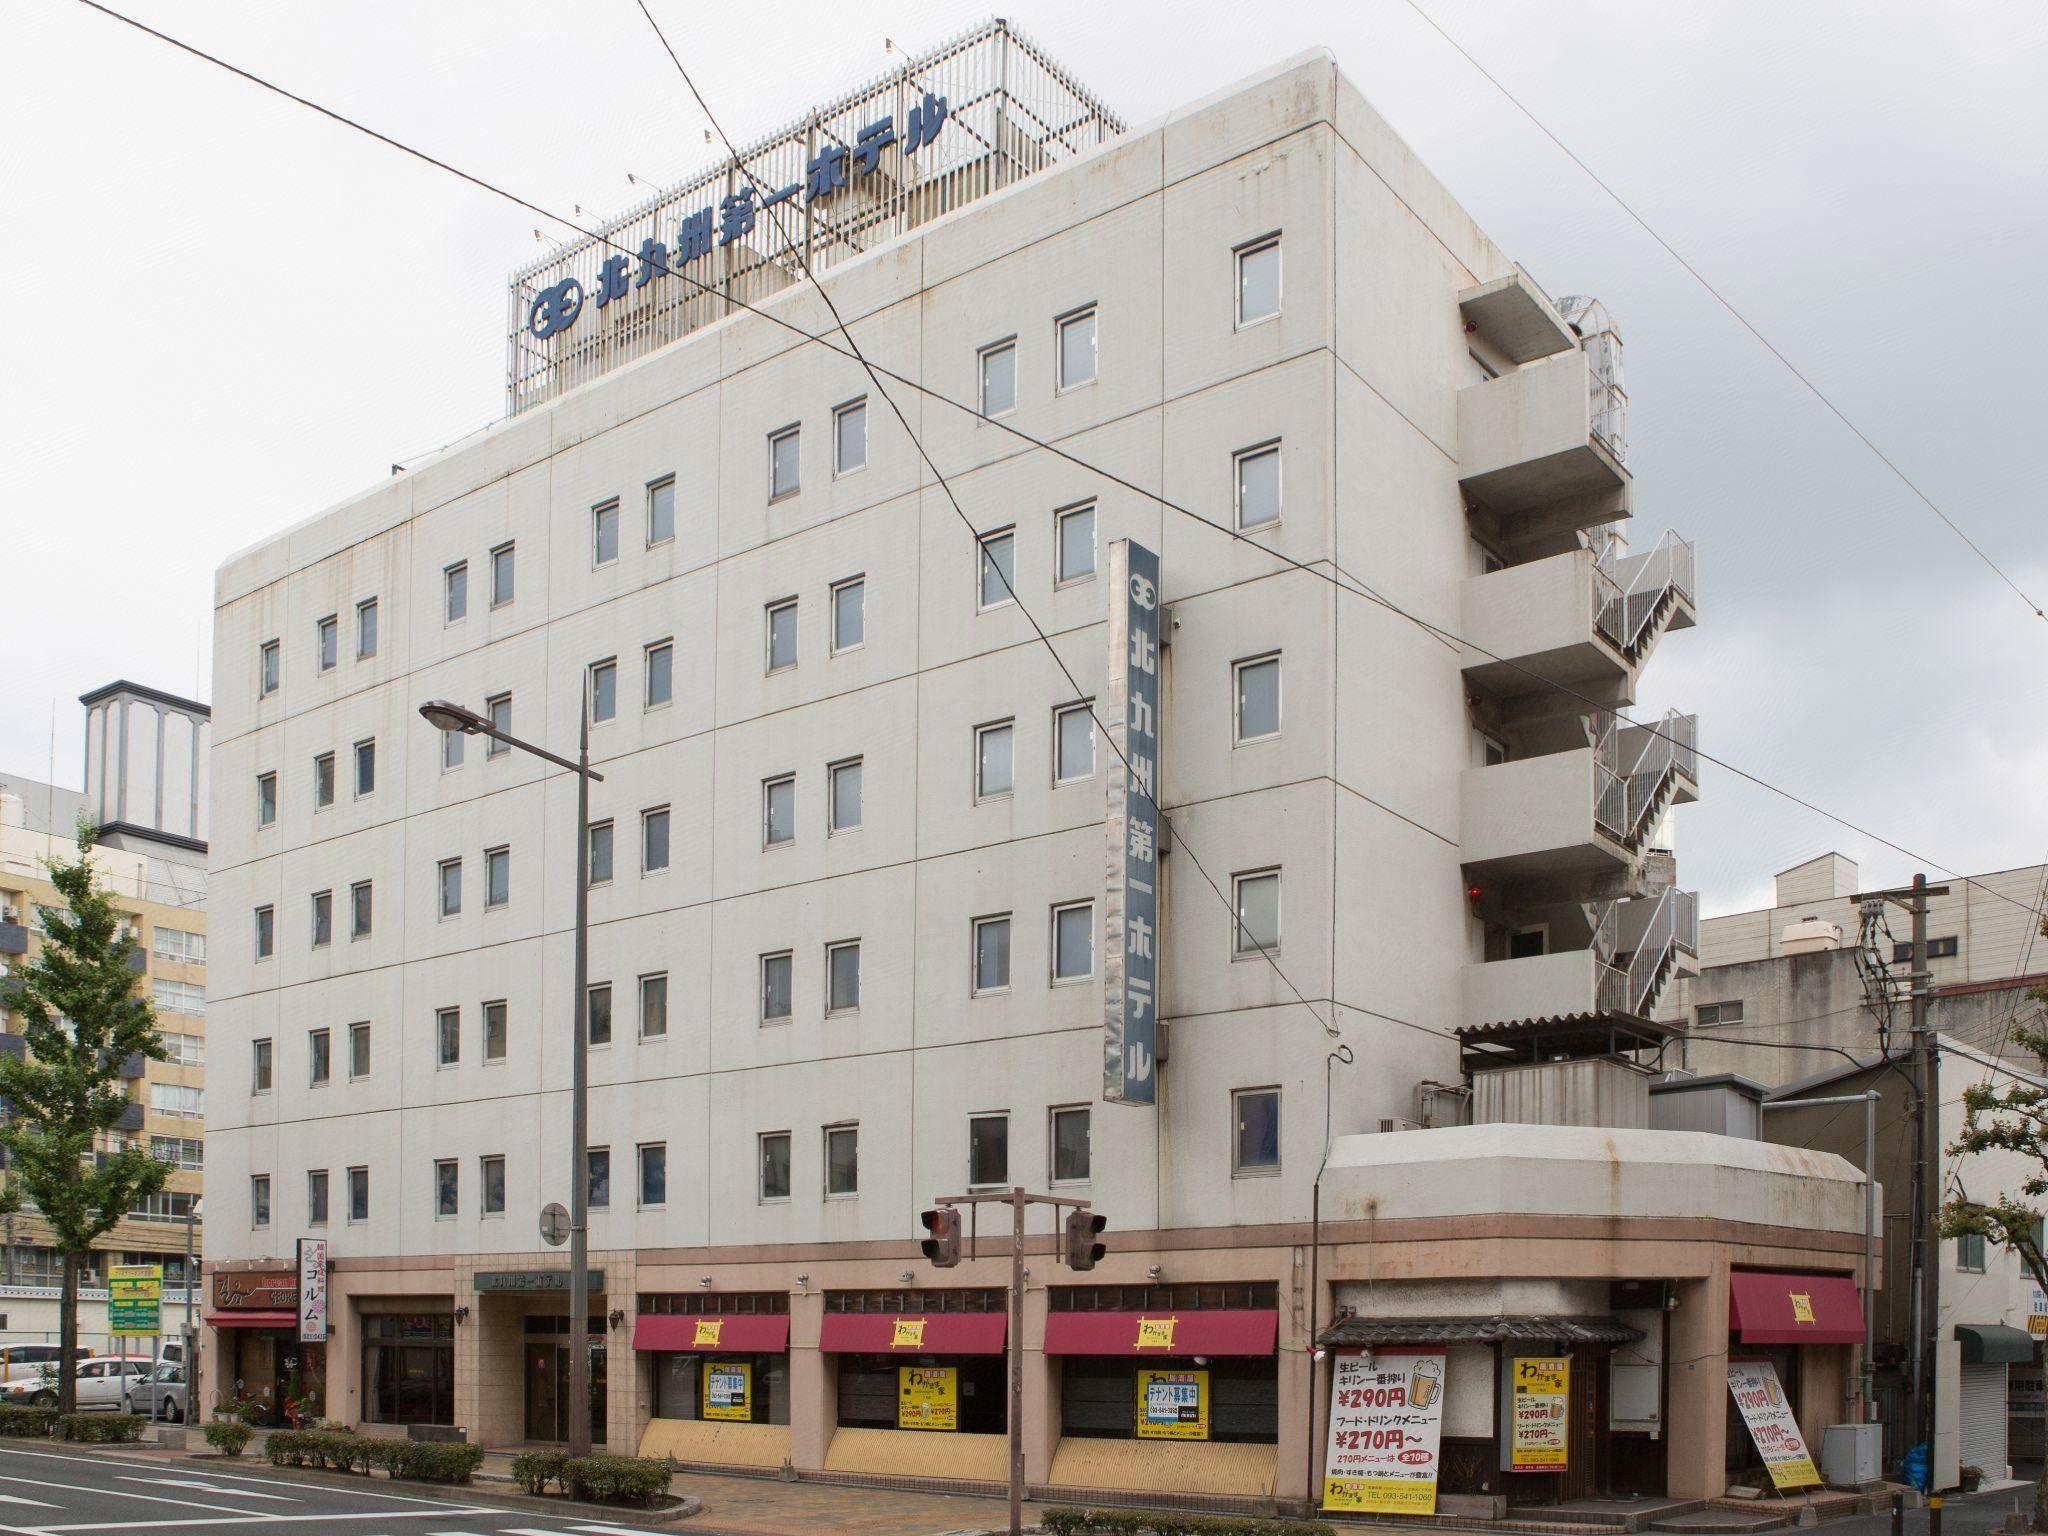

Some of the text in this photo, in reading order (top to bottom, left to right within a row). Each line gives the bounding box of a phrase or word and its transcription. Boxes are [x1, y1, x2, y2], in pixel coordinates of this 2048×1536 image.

[596, 92, 947, 308] 北九州第一ホテル
[1129, 627, 1155, 1082] 北九州第一ホテル
[304, 1269, 319, 1321] コルム
[1340, 1361, 1378, 1373] 生ビール
[1339, 1373, 1406, 1386] キリン一番搾り
[1150, 1387, 1196, 1404] テナント募集中
[1338, 1387, 1406, 1408] ¥290円
[1735, 1389, 1770, 1410] ¥290円
[1518, 1409, 1548, 1419] ¥290円
[1337, 1454, 1395, 1463] 270円メニューは
[1383, 1491, 1433, 1501] 093-541-1060
